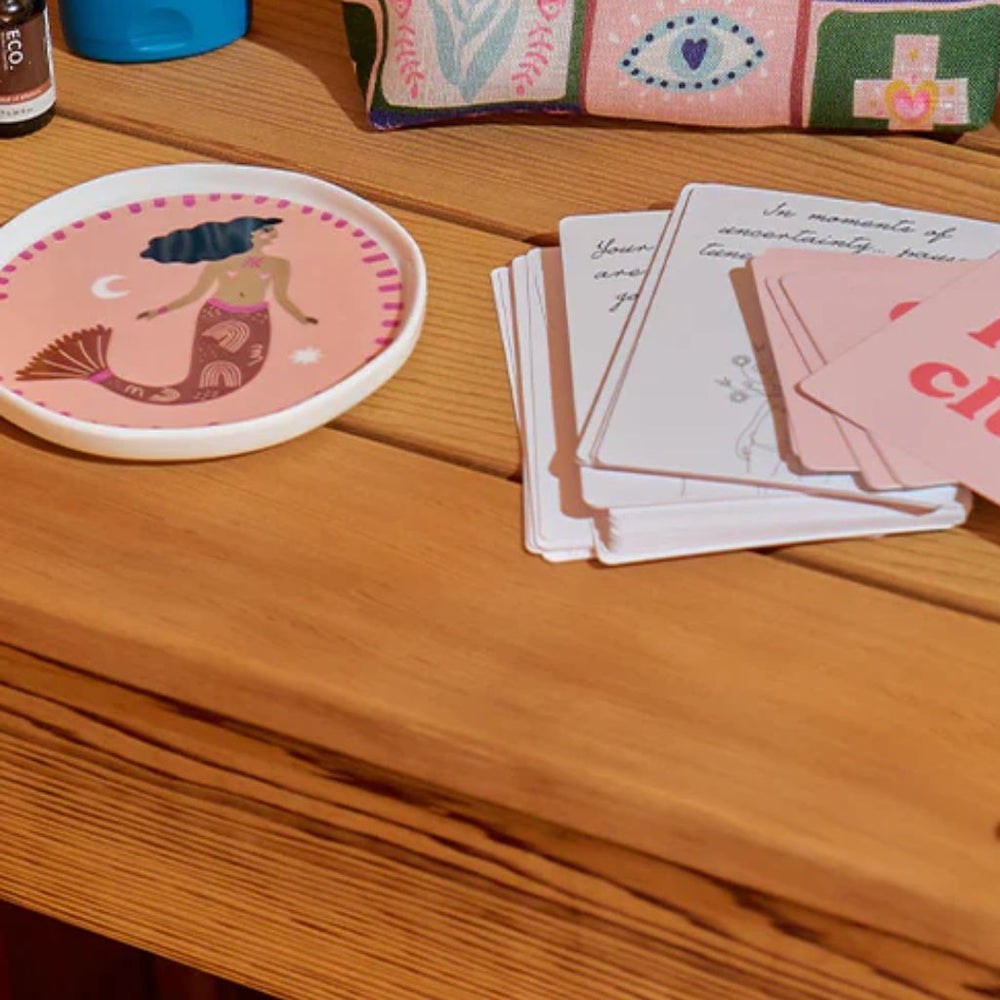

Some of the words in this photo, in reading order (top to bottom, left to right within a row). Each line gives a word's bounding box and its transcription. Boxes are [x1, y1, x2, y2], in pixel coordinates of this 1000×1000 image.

[763, 201, 796, 217] In
[808, 212, 916, 234] moments
[924, 226, 957, 245] of
[590, 238, 655, 260] Your
[594, 268, 645, 280] are
